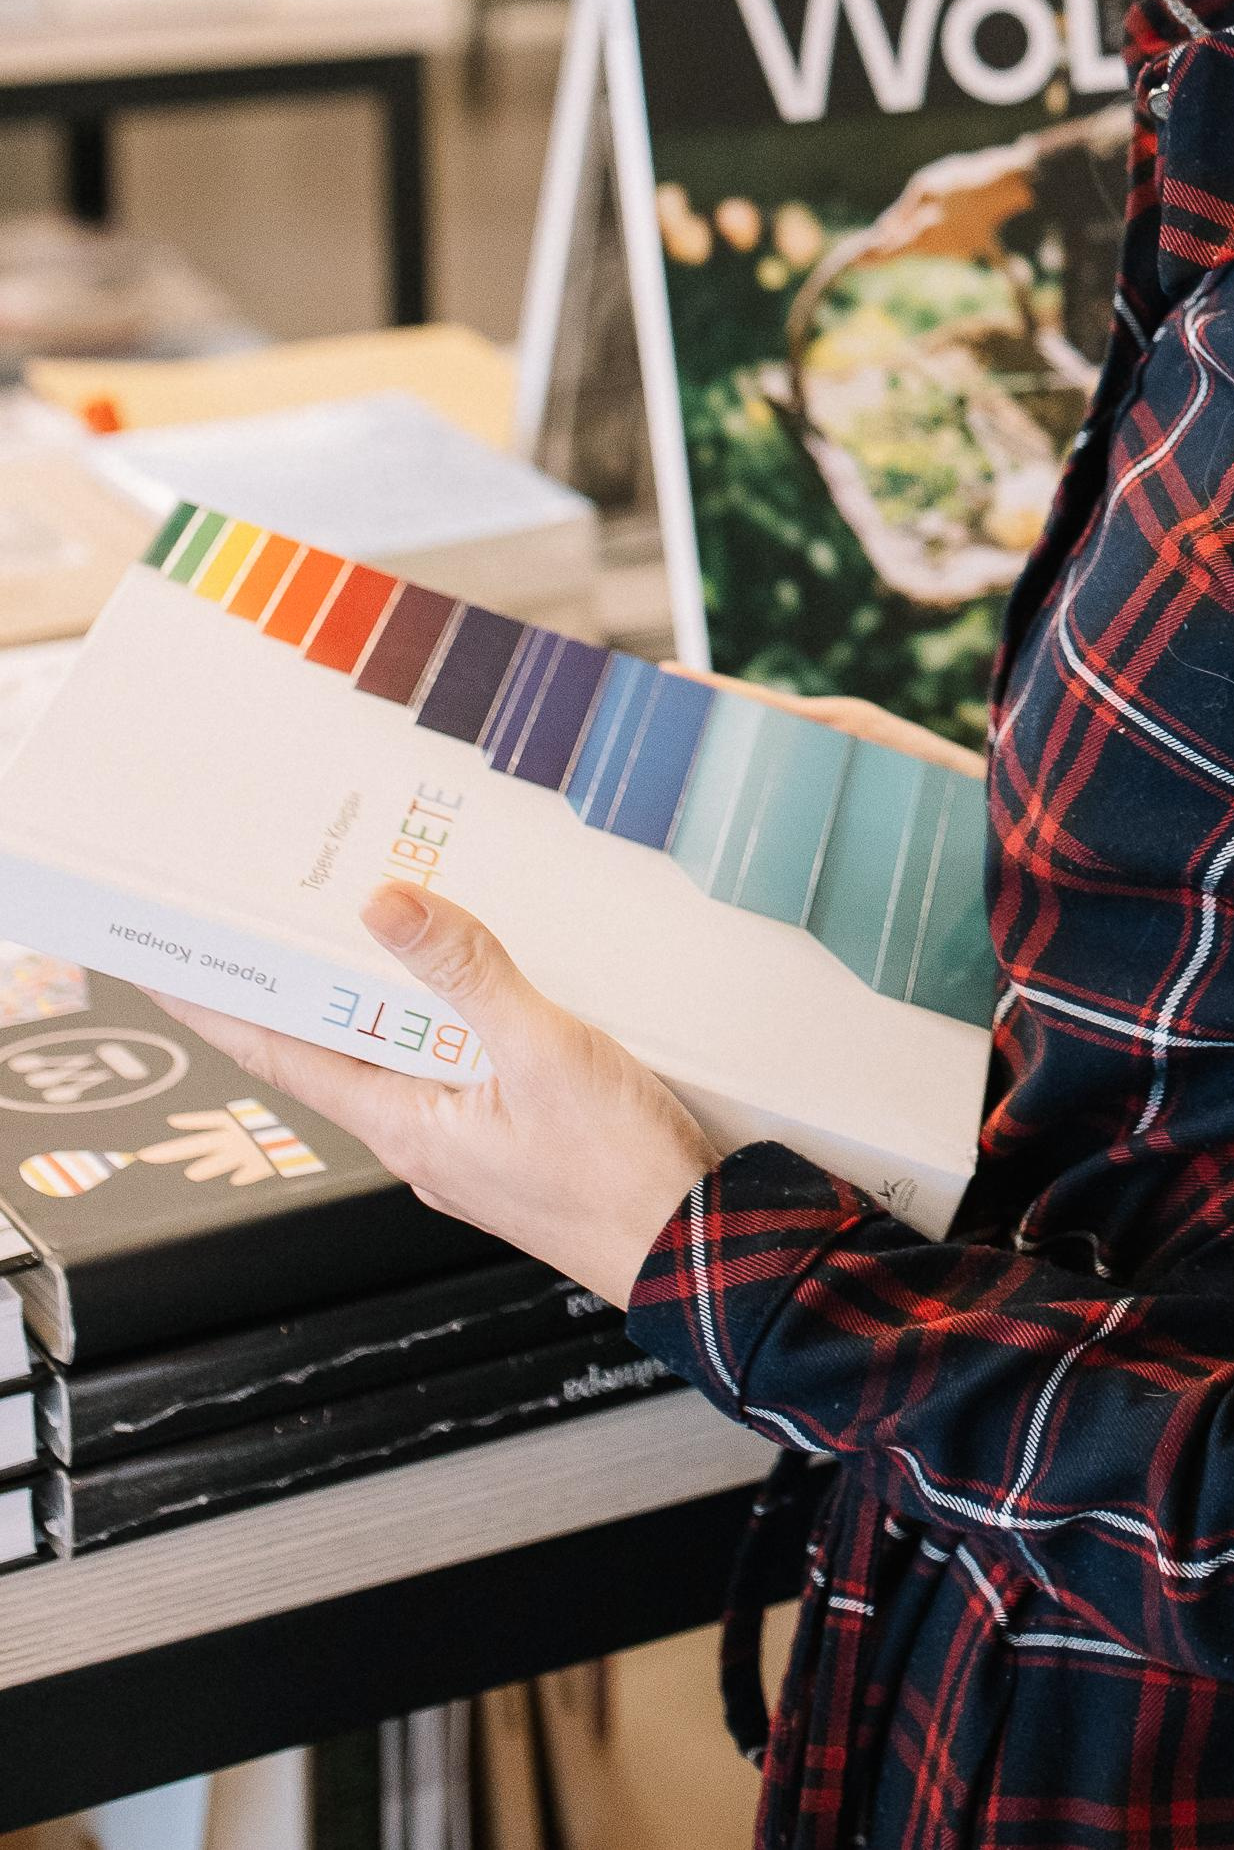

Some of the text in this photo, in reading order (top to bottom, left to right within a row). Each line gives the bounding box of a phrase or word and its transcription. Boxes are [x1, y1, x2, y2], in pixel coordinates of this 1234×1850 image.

[299, 842, 339, 892] Теренс
[109, 922, 278, 994] Теренс Конран
